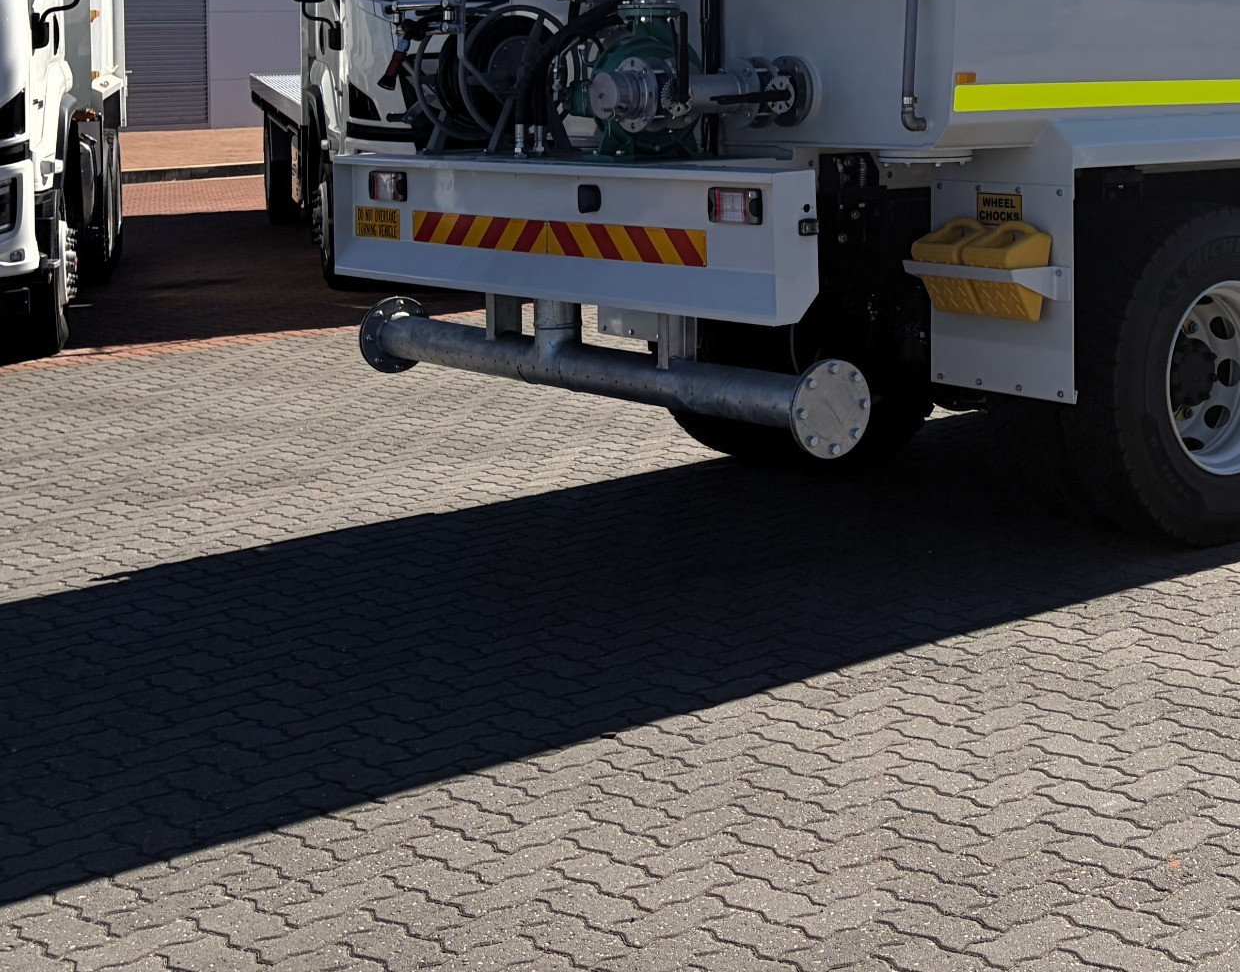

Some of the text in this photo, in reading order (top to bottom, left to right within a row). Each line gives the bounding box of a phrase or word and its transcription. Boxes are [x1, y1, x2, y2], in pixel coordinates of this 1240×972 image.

[982, 197, 1016, 208] WHEEL
[357, 208, 398, 223] DO NOT OVERTAKE
[979, 210, 1020, 222] CHOCKS
[357, 222, 398, 239] TURNING VEHICLE
